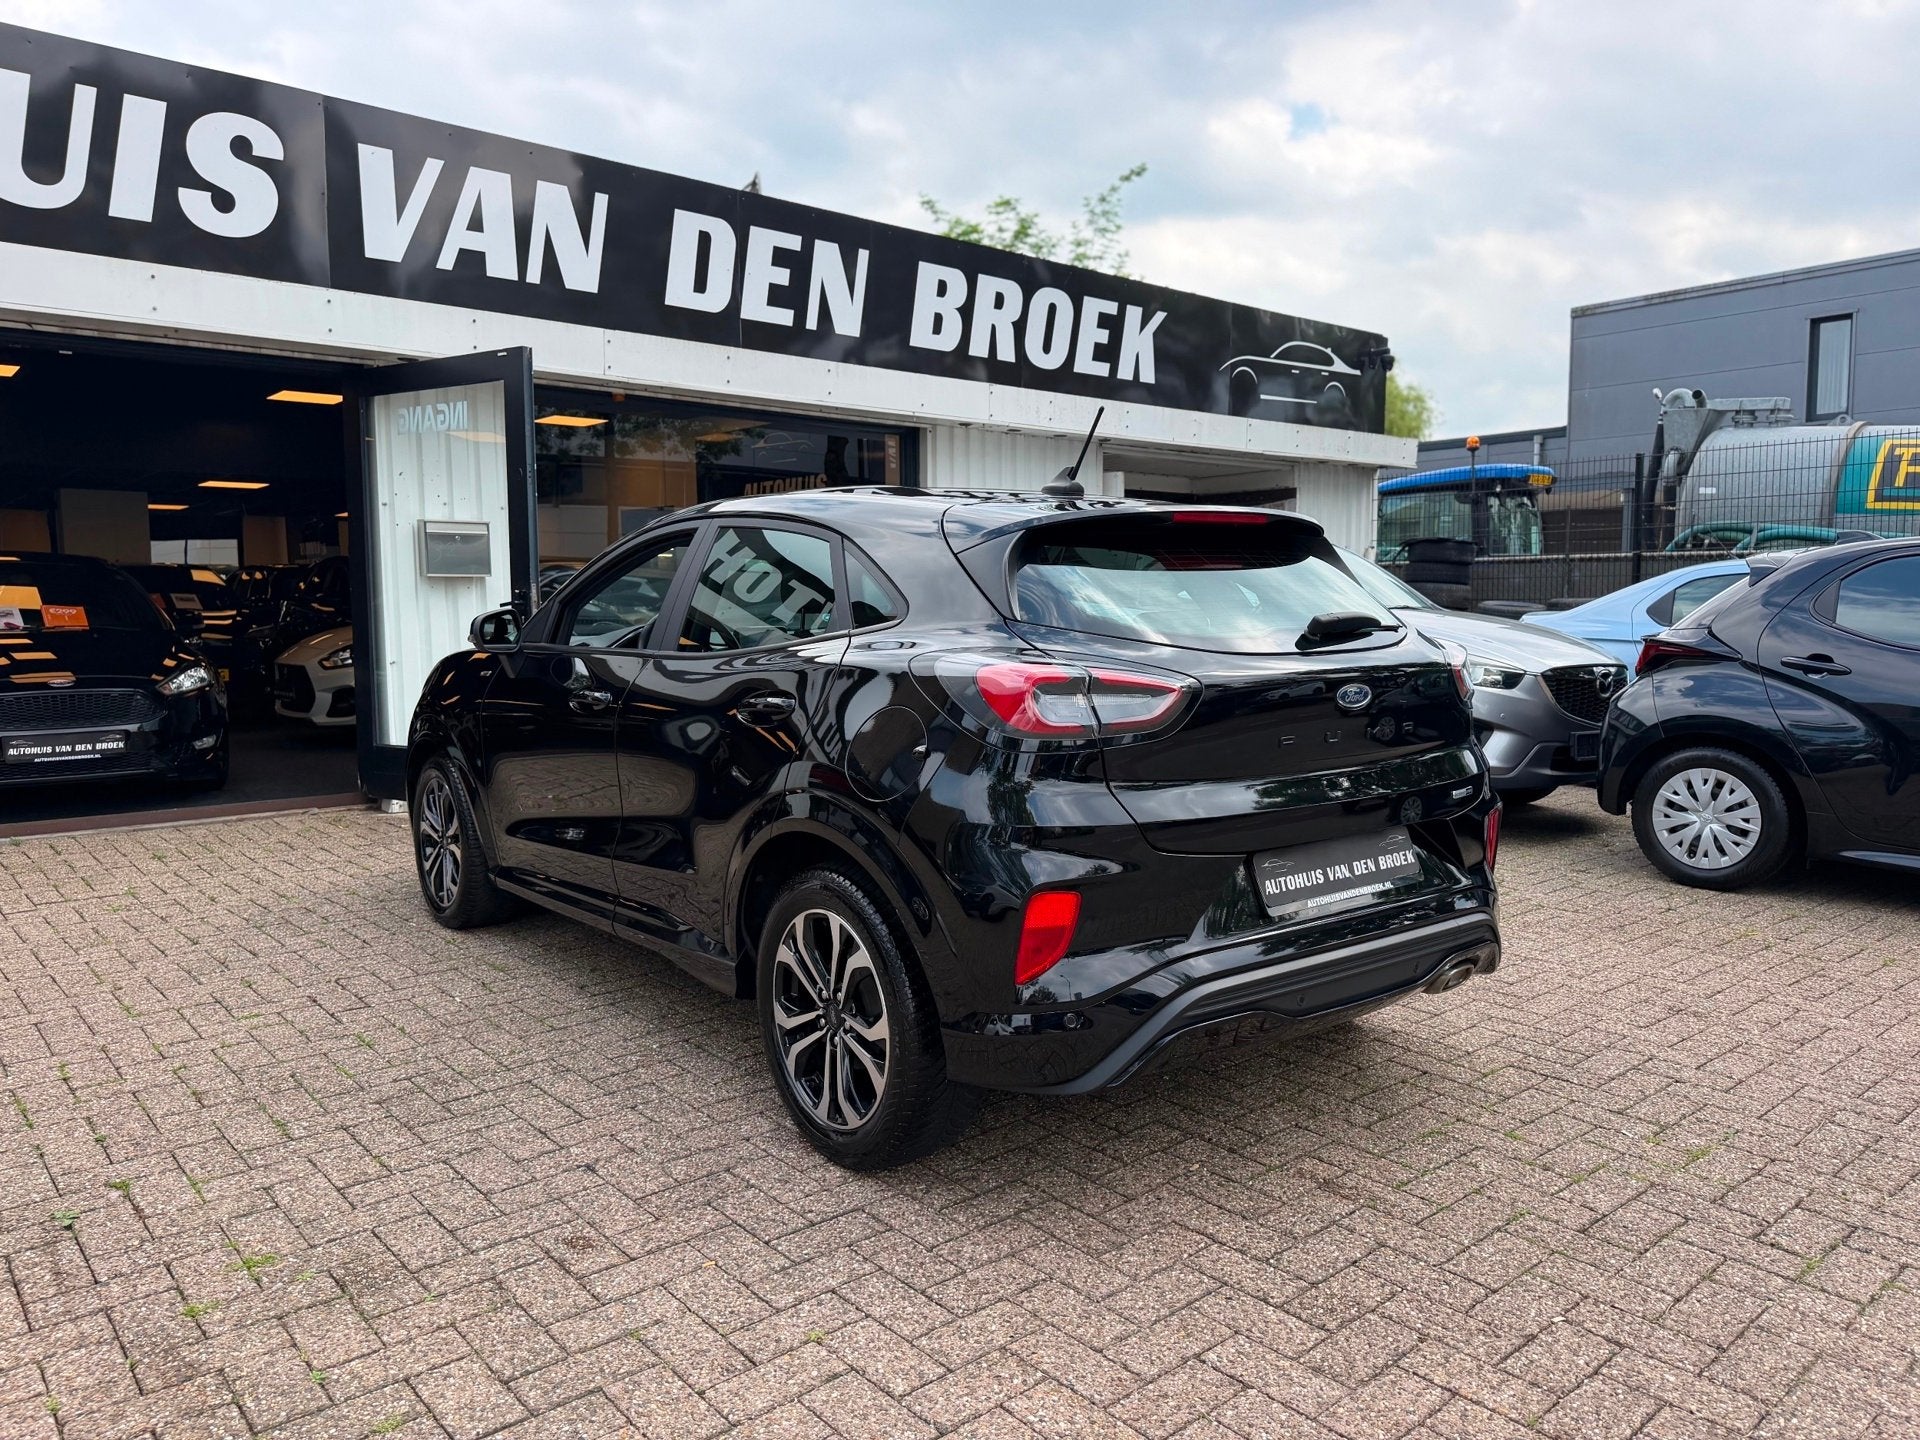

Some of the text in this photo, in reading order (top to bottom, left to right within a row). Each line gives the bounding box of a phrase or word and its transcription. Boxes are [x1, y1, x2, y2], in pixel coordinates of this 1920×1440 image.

[358, 143, 608, 293] VAN
[665, 208, 869, 337] DEN
[909, 261, 1167, 384] BROEK
[8, 741, 125, 755] AUTOHUIS VAN DEN BROEK
[1265, 849, 1415, 895] AUTOHUIS VAN DEN BROEK
[1307, 881, 1394, 908] AUTOHUISVANDENBROEK.NL
